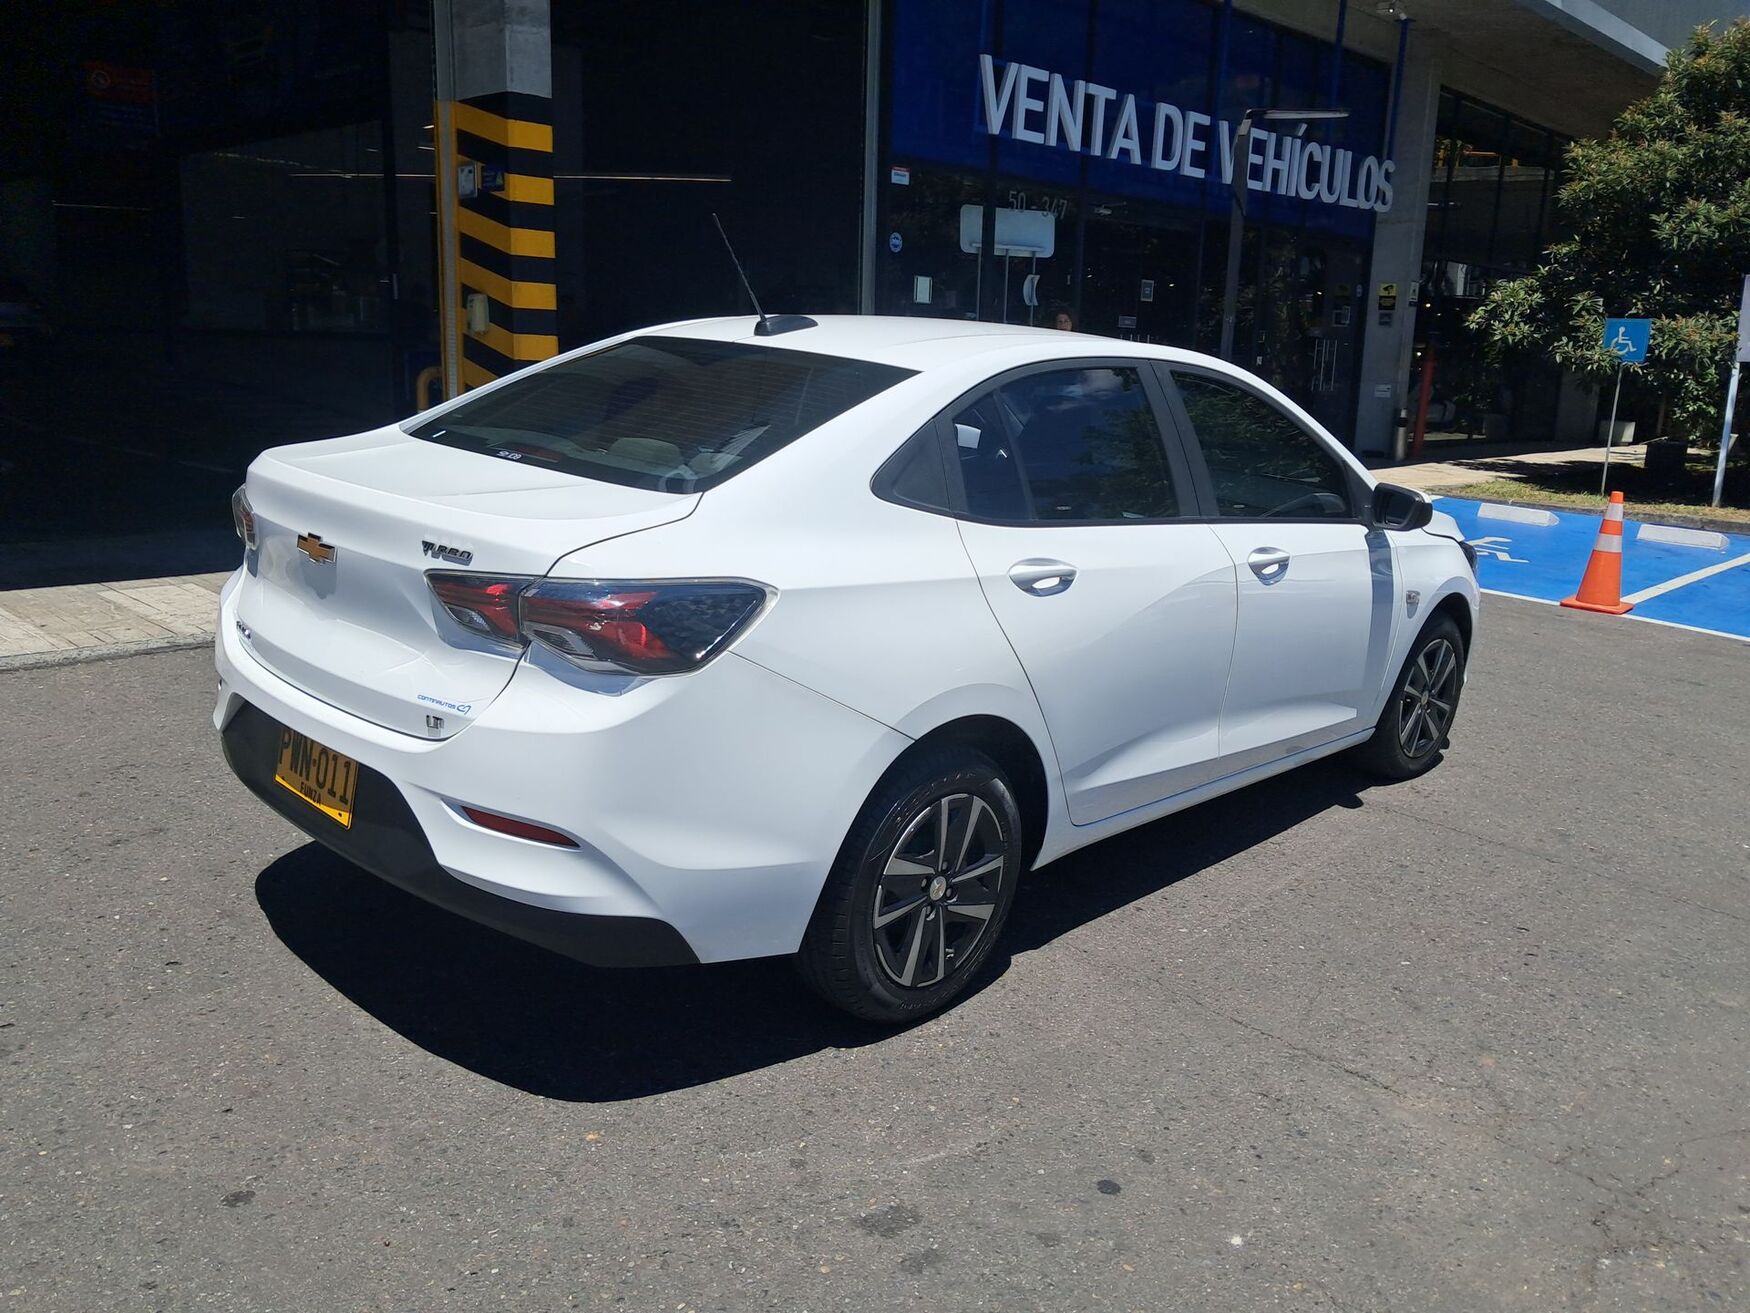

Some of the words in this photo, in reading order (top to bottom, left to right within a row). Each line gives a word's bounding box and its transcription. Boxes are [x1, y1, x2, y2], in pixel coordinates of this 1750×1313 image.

[979, 53, 1141, 165] VENTA
[1151, 102, 1211, 179] DE
[1218, 120, 1396, 213] VEHÍCULOS
[1008, 190, 1026, 213] 50
[300, 781, 321, 805] FUNZA
